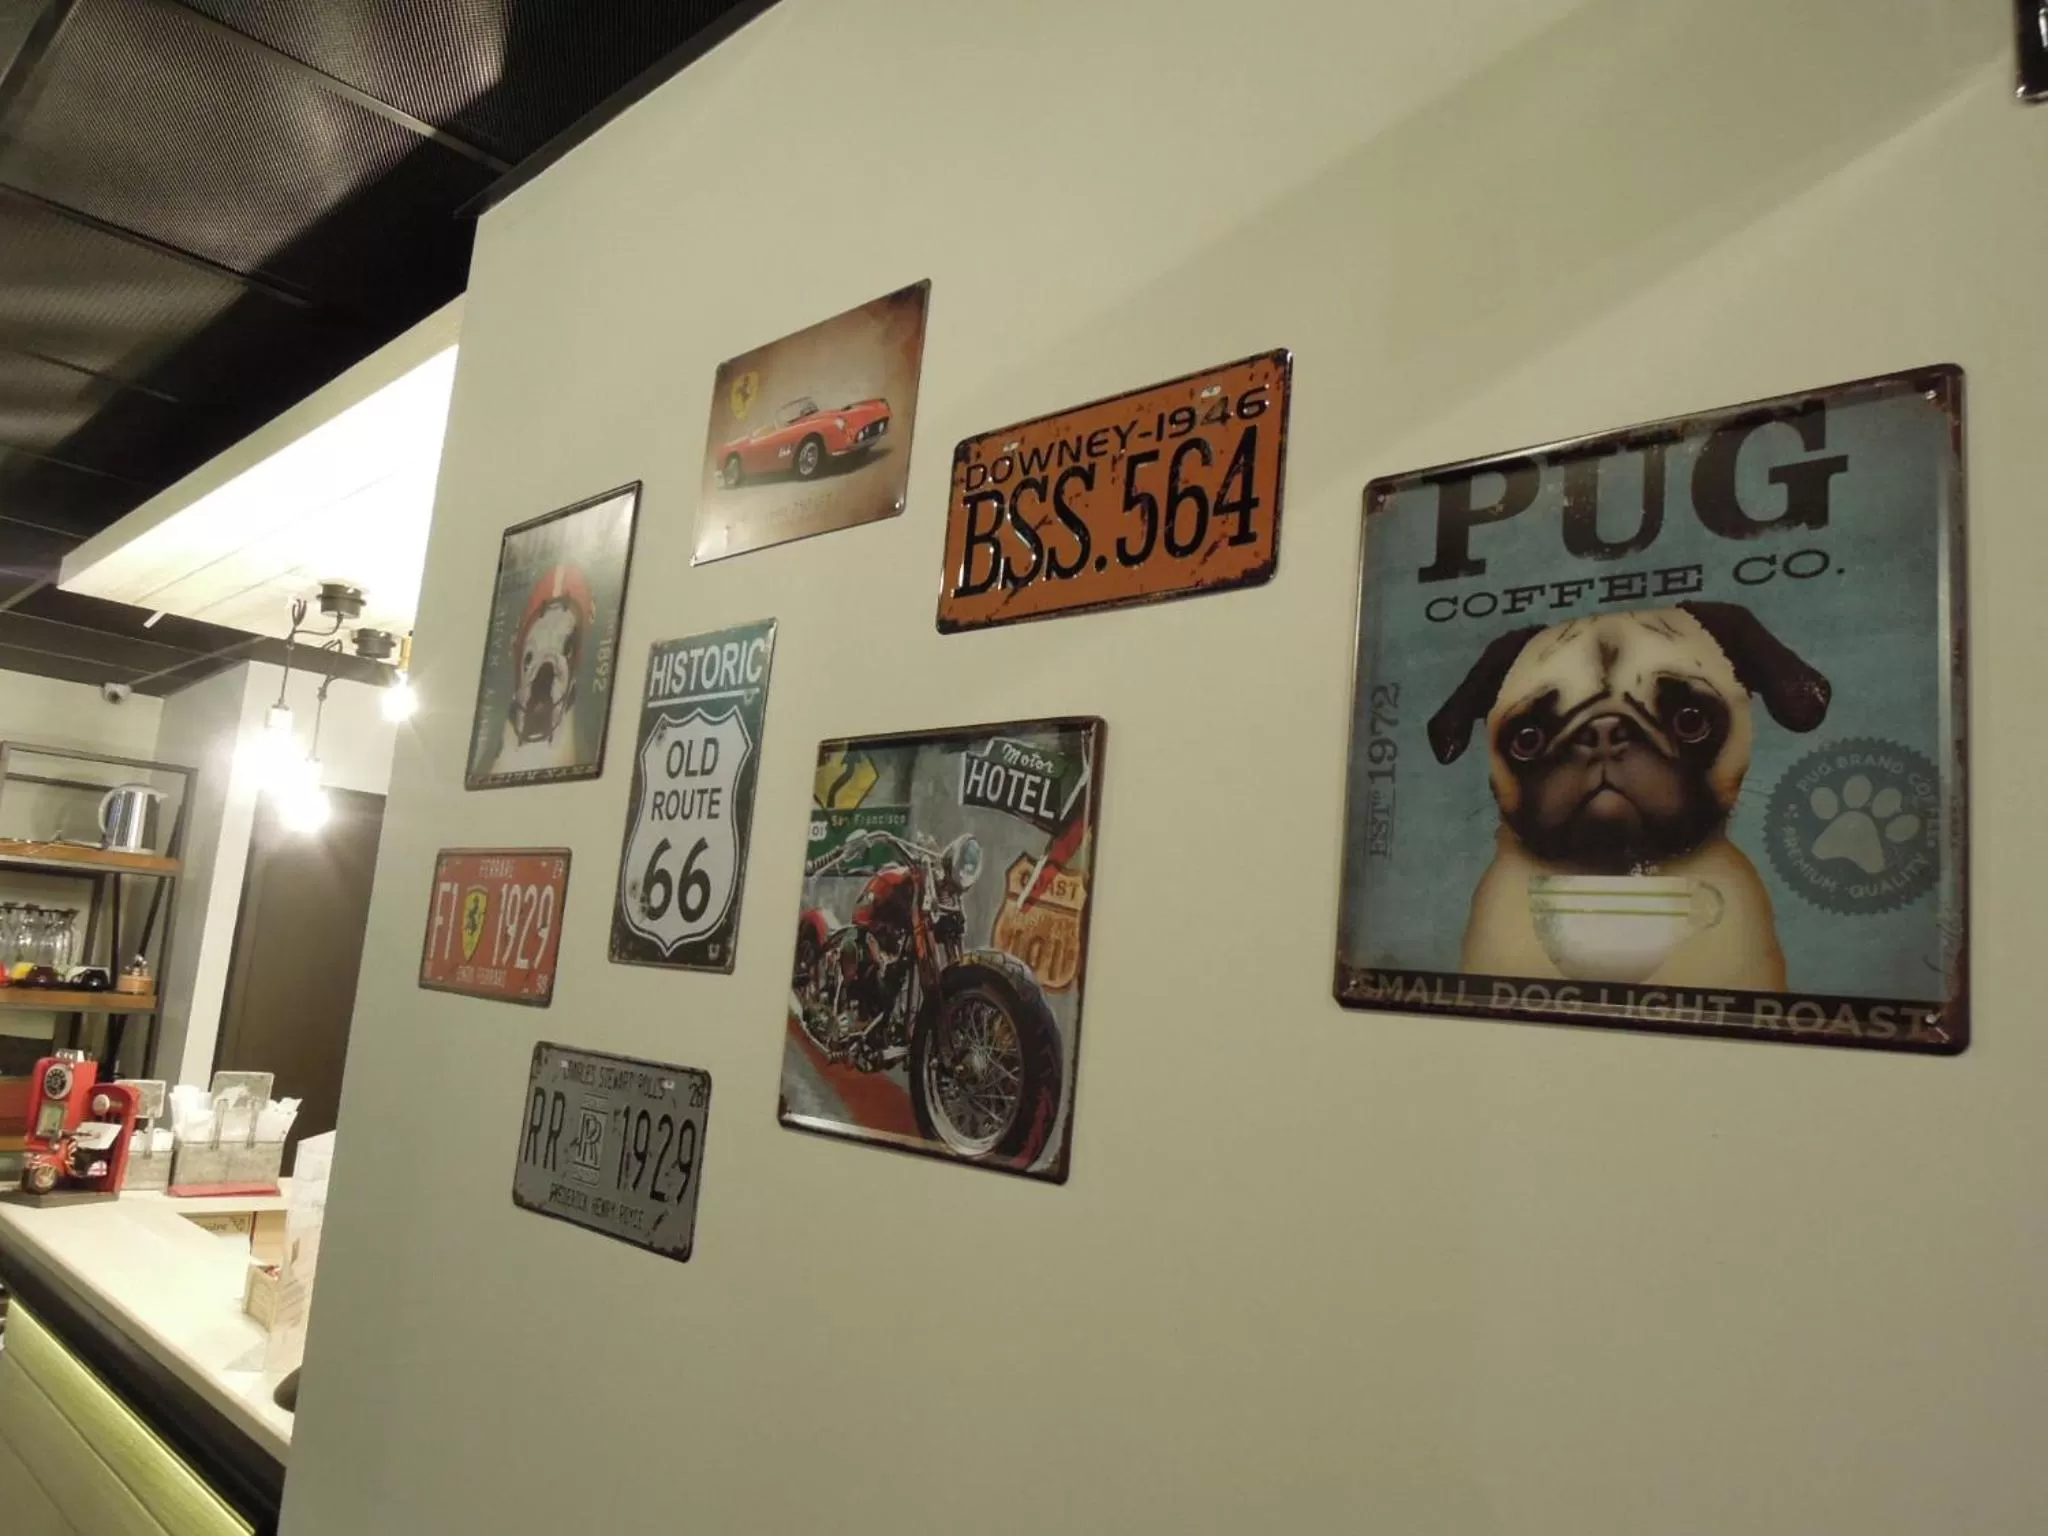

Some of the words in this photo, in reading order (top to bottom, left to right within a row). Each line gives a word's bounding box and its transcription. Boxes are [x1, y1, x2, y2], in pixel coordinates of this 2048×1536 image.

[964, 384, 1269, 492] DOWNEY-1946
[952, 424, 1261, 599] BSS.564
[1418, 398, 1849, 583] PUG
[1424, 564, 1704, 623] COFFEE
[1732, 548, 1846, 586] CO.
[650, 636, 765, 698] HISTORIC
[665, 736, 720, 779] OLD
[1367, 682, 1400, 785] 1972
[1836, 752, 1905, 775] BRAND
[651, 787, 722, 822] ROUTE
[965, 757, 1055, 821] HOTEL
[641, 836, 711, 924] 66
[491, 882, 555, 970] 1929
[1354, 969, 1476, 1007] SMALL
[1490, 981, 1584, 1013] DOG
[1601, 988, 1736, 1027] LIGHT
[1752, 997, 1939, 1043] ROAST
[525, 1086, 566, 1173] RR
[616, 1105, 697, 1205] 1929
